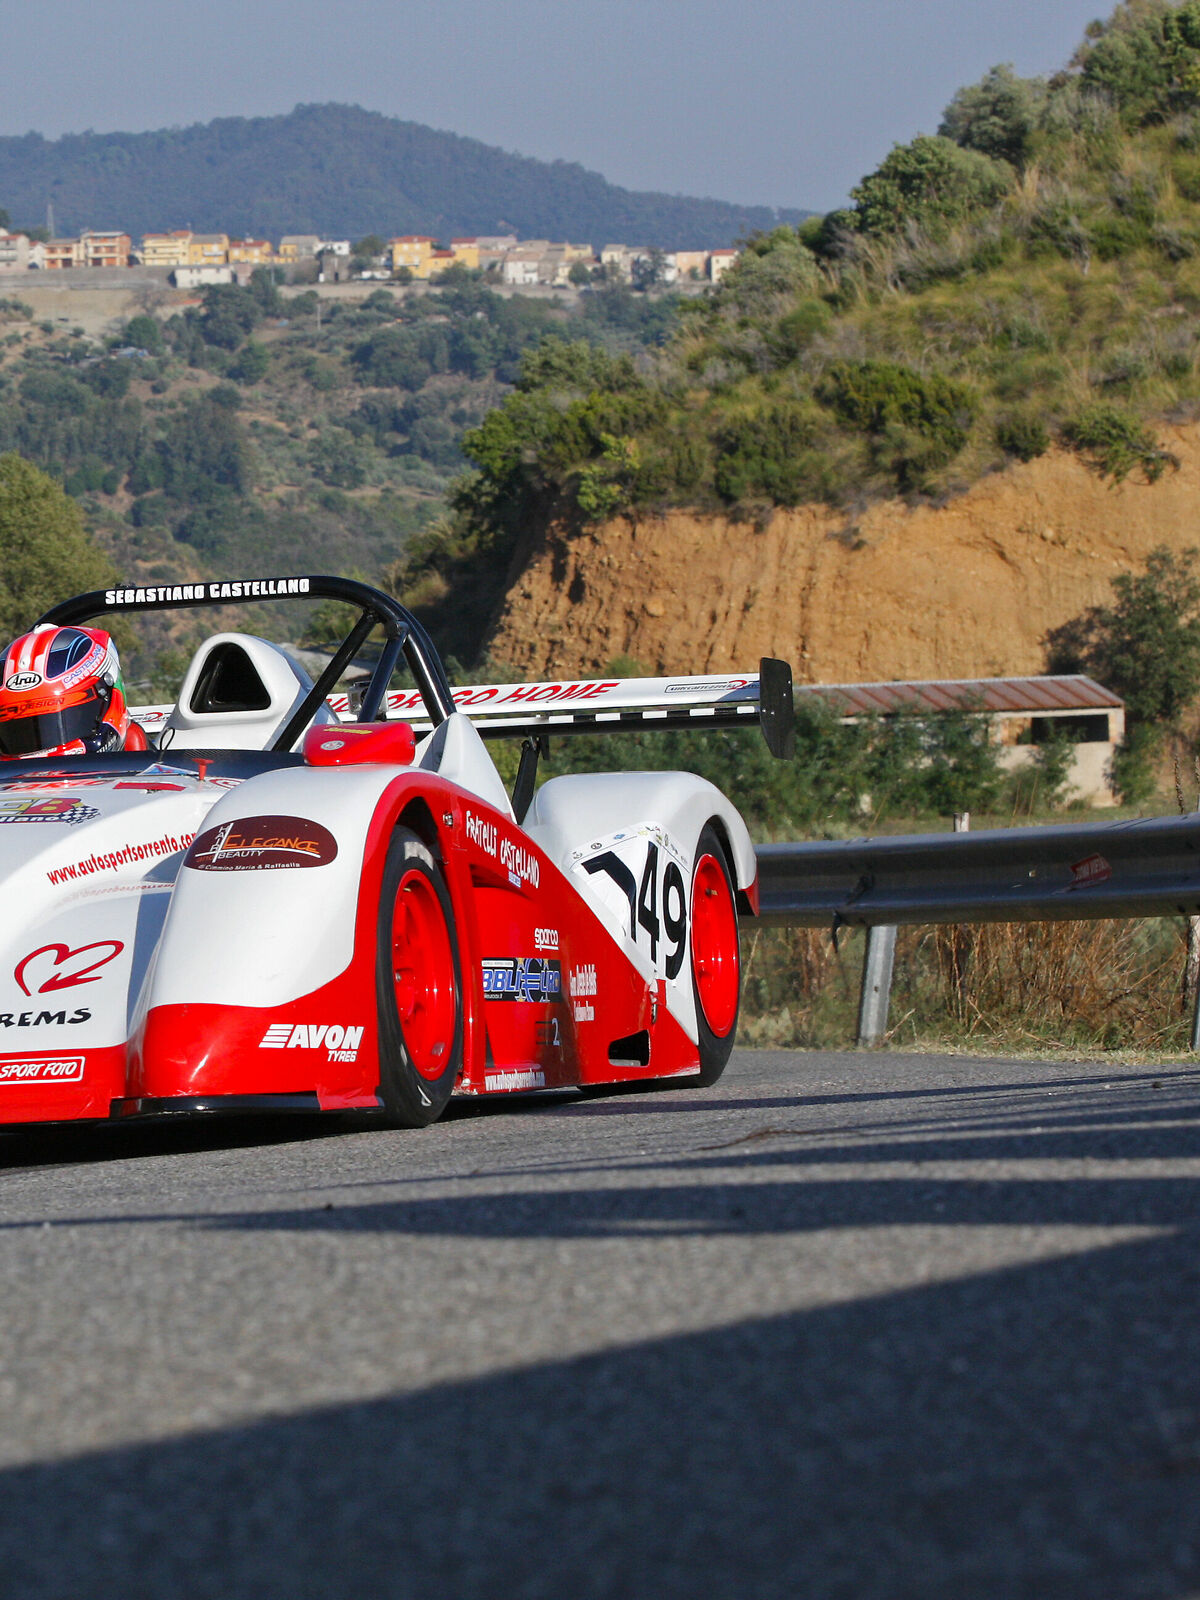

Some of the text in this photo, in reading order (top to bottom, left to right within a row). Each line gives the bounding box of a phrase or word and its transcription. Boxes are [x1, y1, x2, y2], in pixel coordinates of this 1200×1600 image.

[105, 578, 310, 604] SEBASTIANO CASTELLANO
[7, 674, 37, 688] Arai
[498, 682, 620, 704] HOME
[222, 834, 320, 854] ELEGANCE
[217, 850, 265, 860] BEAUTY
[534, 928, 559, 951] sparco
[286, 1024, 365, 1049] AVON
[327, 1050, 357, 1062] TYRES
[43, 1062, 78, 1076] FOTO
